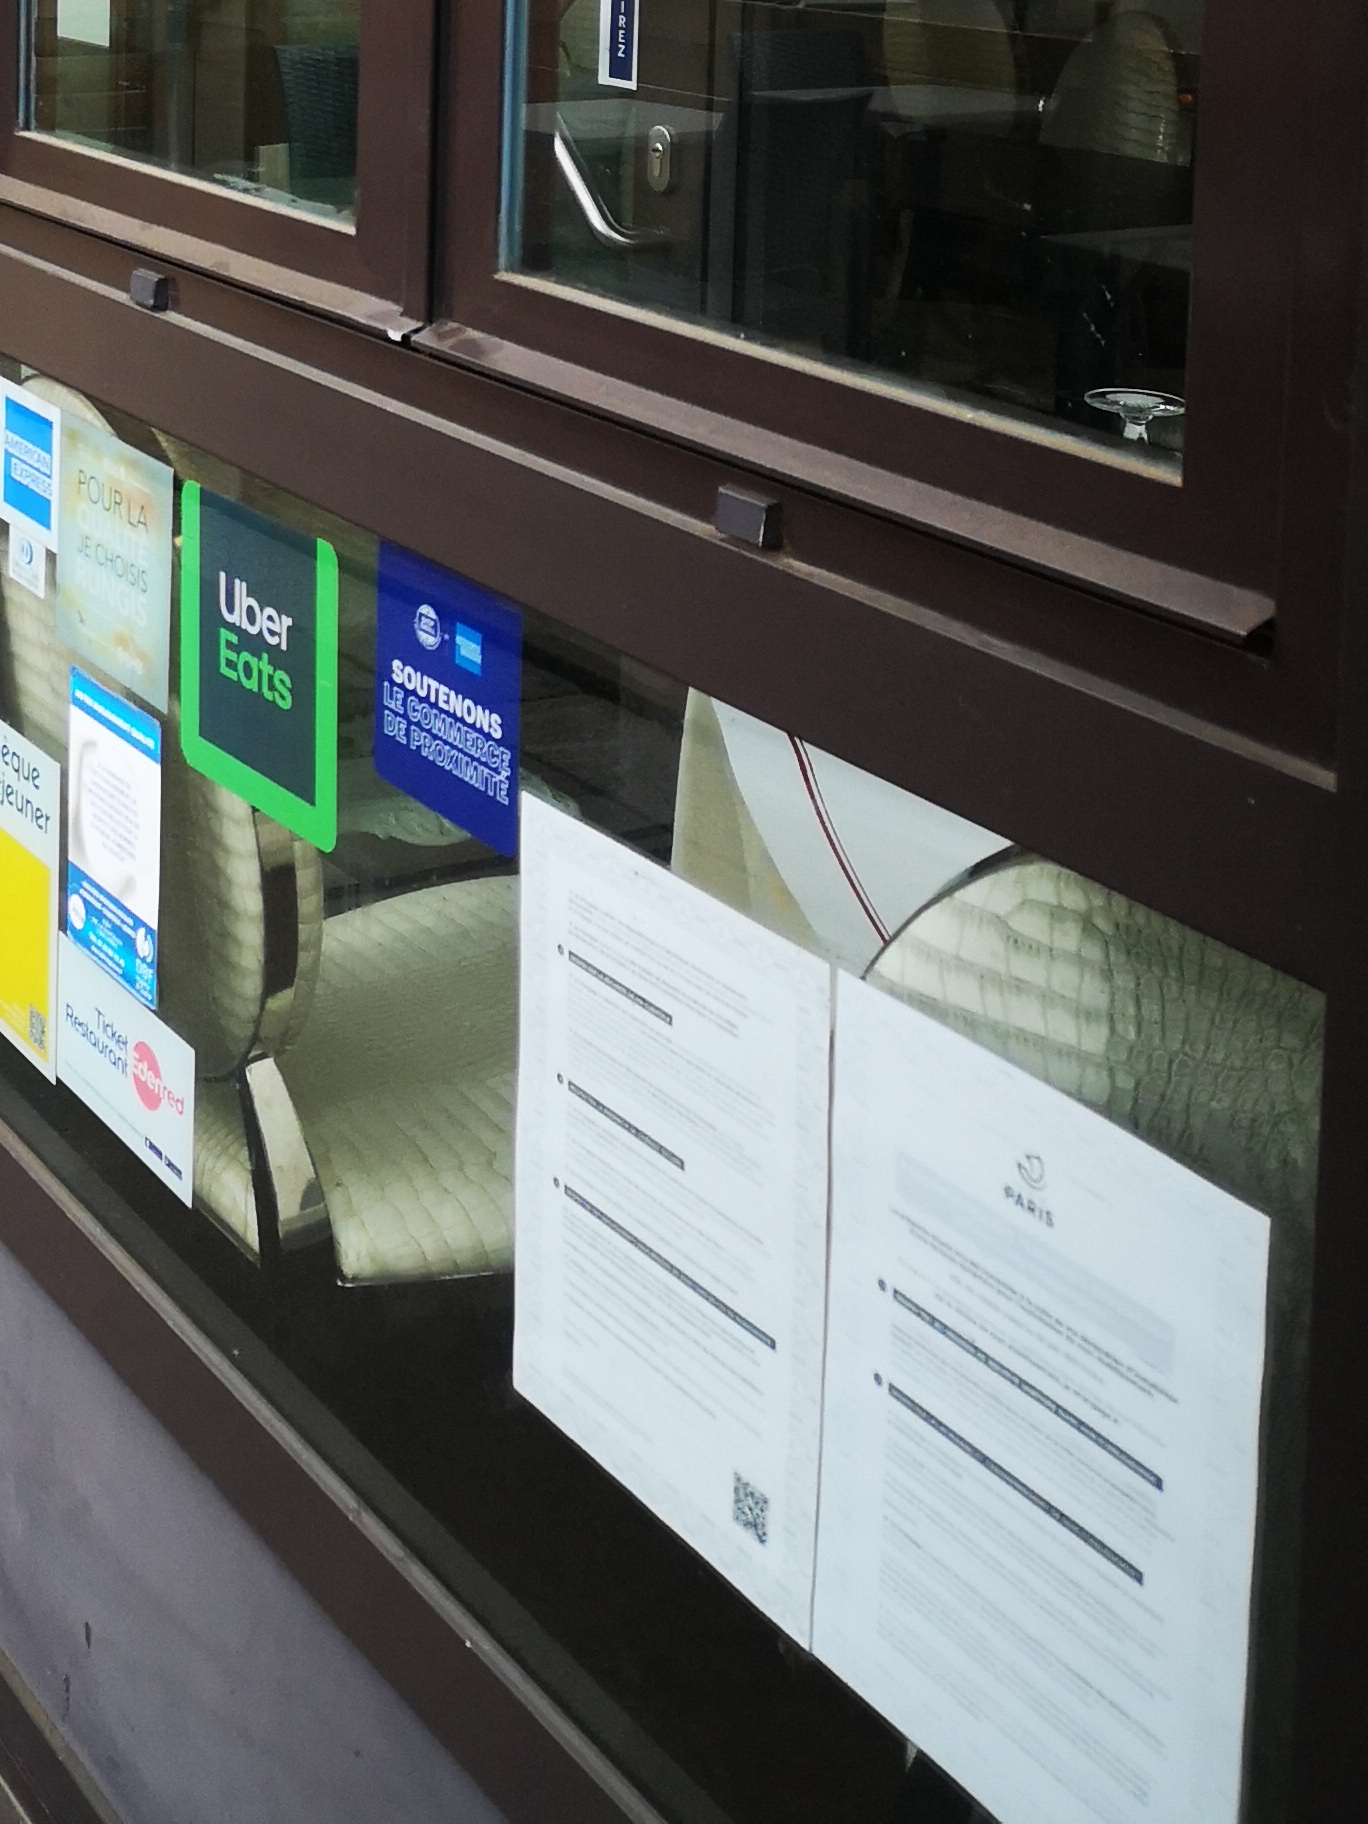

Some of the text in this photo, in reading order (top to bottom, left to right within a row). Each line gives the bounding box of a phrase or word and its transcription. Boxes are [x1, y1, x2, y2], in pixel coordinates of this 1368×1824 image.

[77, 469, 149, 534] POUR LA
[77, 535, 149, 594] JE CHOISIS
[219, 571, 293, 651] Uber
[218, 627, 293, 710] Eats
[391, 659, 503, 740] SOUTENONS
[383, 681, 512, 776] LE COMMERCE
[384, 709, 510, 806] DE PROXIMITÉ
[65, 1002, 129, 1078] Restaurant
[95, 1007, 129, 1053] Ticket
[131, 1051, 185, 1117] Edenred
[1003, 1185, 1055, 1229] PARIS
